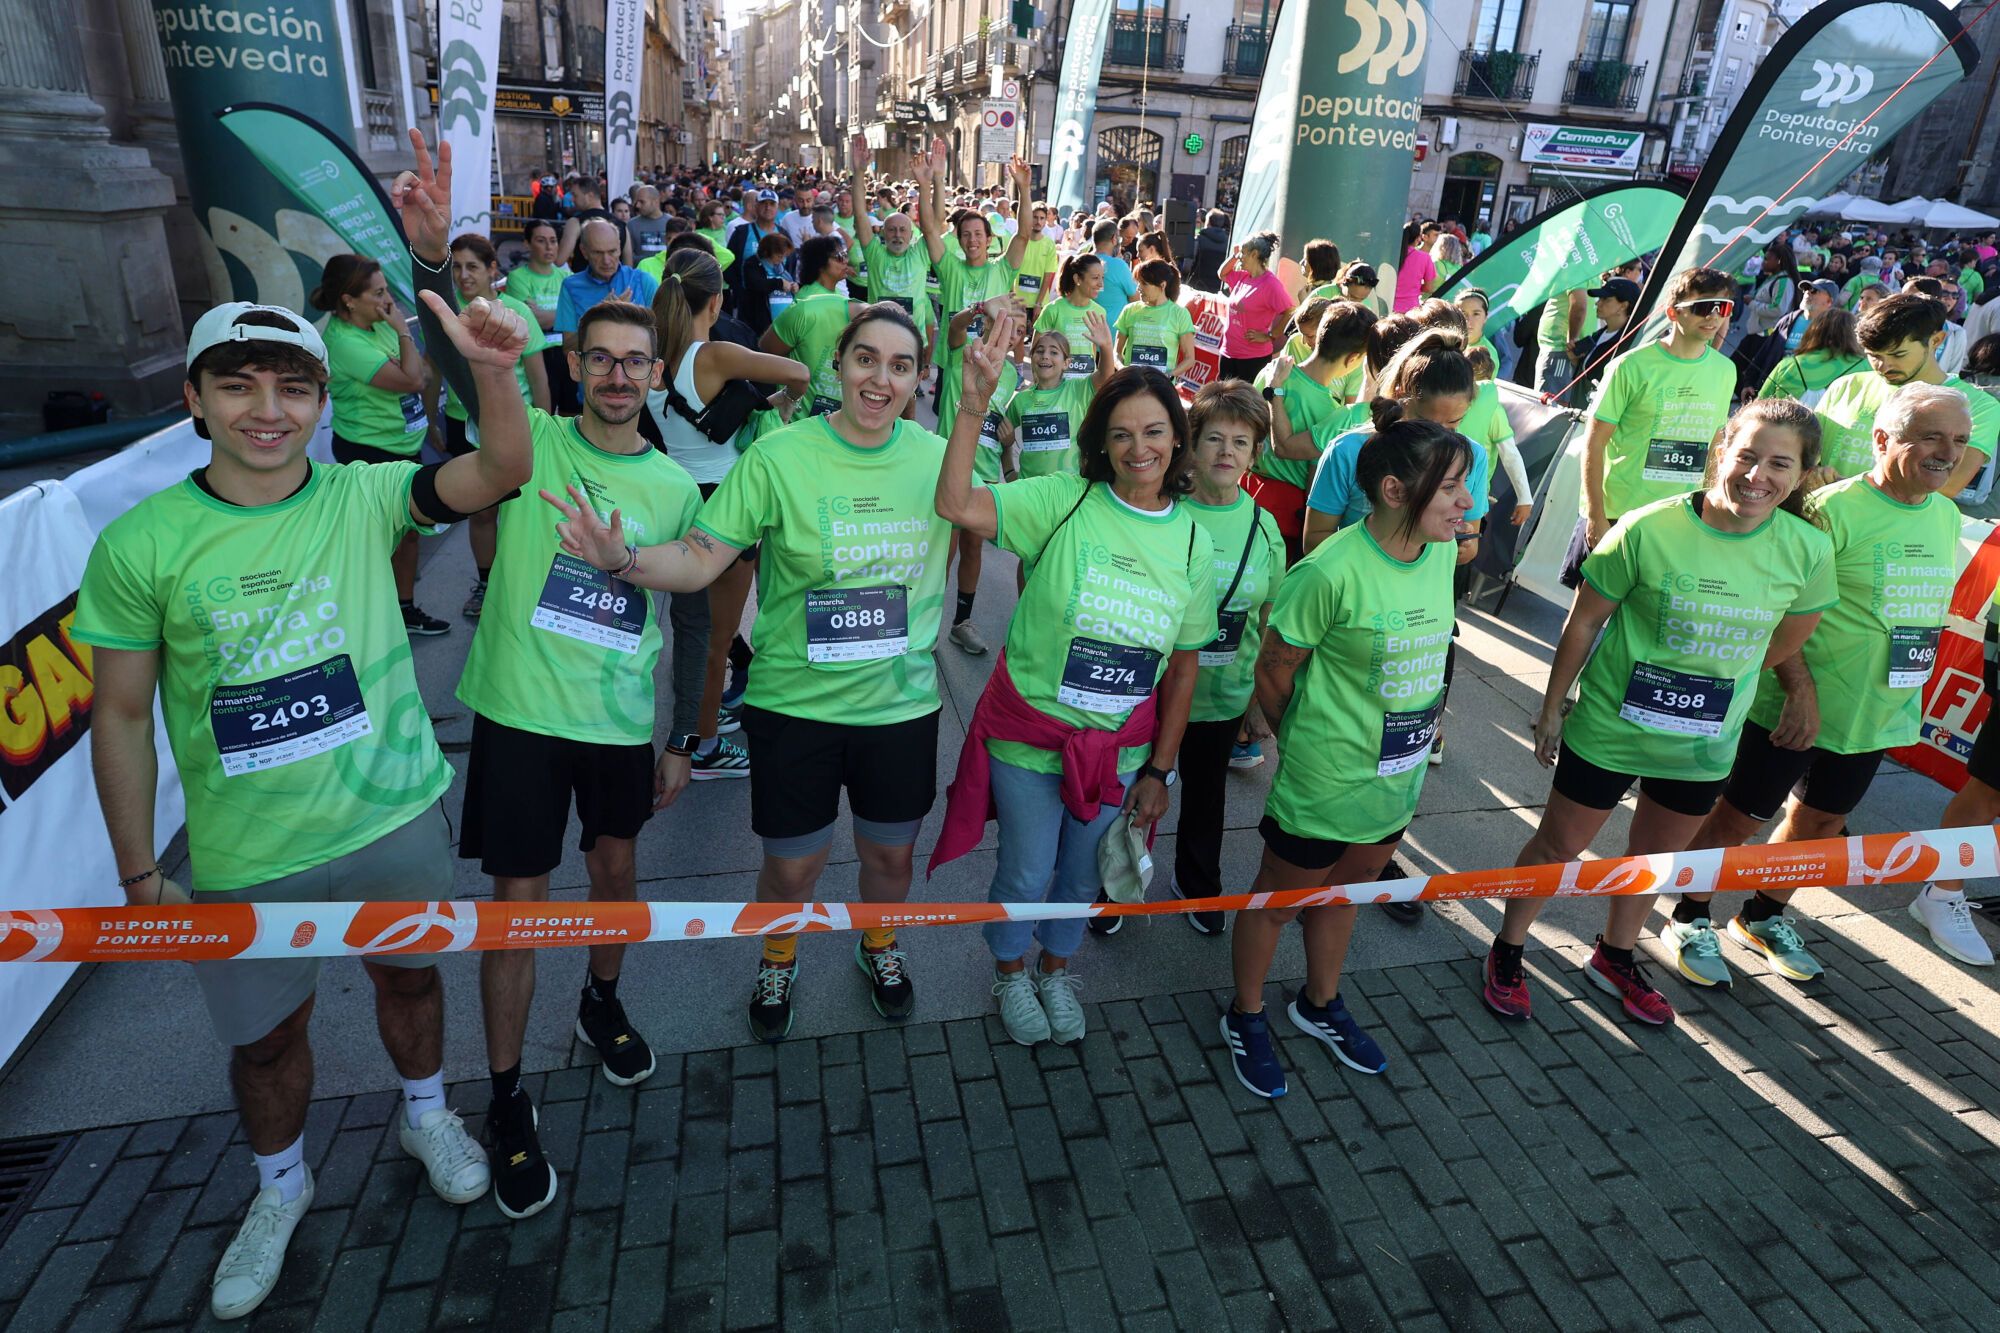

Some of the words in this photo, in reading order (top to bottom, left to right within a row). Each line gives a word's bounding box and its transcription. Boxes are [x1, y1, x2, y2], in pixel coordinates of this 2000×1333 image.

[154, 4, 323, 43] eputación
[614, 0, 626, 80] Deputaci
[626, 0, 638, 83] Ponteved
[162, 40, 328, 77] ontevedra
[1065, 14, 1089, 111] Deputación
[1075, 15, 1099, 112] Pontevedra
[895, 111, 914, 119] Deza
[1300, 94, 1422, 123] Deputació
[1765, 109, 1879, 138] Deputación
[1557, 131, 1602, 144] CENTRO
[1604, 134, 1629, 146] FUJI
[1759, 124, 1872, 154] Pontevedra
[1574, 218, 1599, 266] Tenemos
[1196, 312, 1224, 337] FROIZ
[1068, 361, 1088, 370] 0657
[1139, 353, 1159, 362] 0848
[1184, 361, 1211, 384] ROIZ
[1032, 424, 1058, 435] 1046
[1663, 453, 1693, 466] 1813
[833, 520, 858, 537] En
[863, 516, 928, 535] marcha
[834, 539, 914, 562] contra
[918, 541, 928, 557] o
[239, 569, 282, 582] asociación
[554, 563, 564, 572] en
[565, 566, 593, 580] marcha
[556, 556, 598, 575] Pontevedra
[1886, 563, 1906, 577] En
[241, 578, 278, 590] española
[242, 588, 269, 597] contra
[276, 582, 295, 591] canc
[552, 570, 576, 582] contra
[583, 578, 608, 591] cancro
[1063, 540, 1090, 625] PONTEVEDRA
[1087, 566, 1108, 586] En
[1113, 577, 1177, 608] marcha
[1884, 581, 1946, 599] contra
[568, 586, 628, 614] 2488
[1079, 591, 1155, 625] contra
[1159, 615, 1172, 629] o
[1671, 595, 1696, 613] En
[1702, 602, 1774, 622] marcha
[211, 609, 250, 632] En
[317, 601, 338, 621] o
[830, 609, 886, 629] 0888
[1076, 613, 1166, 649] cancro
[1667, 617, 1747, 641] contra
[1752, 628, 1766, 640] o
[1082, 646, 1108, 658] marcha
[1366, 612, 1386, 694] PONTEVEDRA
[1387, 637, 1410, 653] En
[1667, 635, 1757, 660] cancro
[1382, 651, 1445, 676] contra
[1089, 665, 1135, 685] 2274
[1644, 671, 1671, 684] marcha
[213, 699, 224, 707] en
[224, 694, 264, 706] marcha
[214, 685, 267, 699] Pontevedra
[1652, 689, 1706, 709] 1398
[213, 705, 245, 715] contra
[245, 703, 254, 711] o
[255, 694, 291, 710] cancro
[249, 694, 330, 732] 2403
[1396, 719, 1421, 727] marcha
[1407, 716, 1438, 745] 139
[1737, 863, 1826, 876] PONTEVEDRA
[1761, 873, 1824, 883] DEPORTE
[1437, 886, 1534, 898] PONTEVEDRA
[101, 920, 194, 931] DEPORTE
[511, 917, 594, 927] DEPORTE
[96, 934, 230, 945] PONTEVEDRA
[507, 929, 628, 938] PONTEVEDRA
